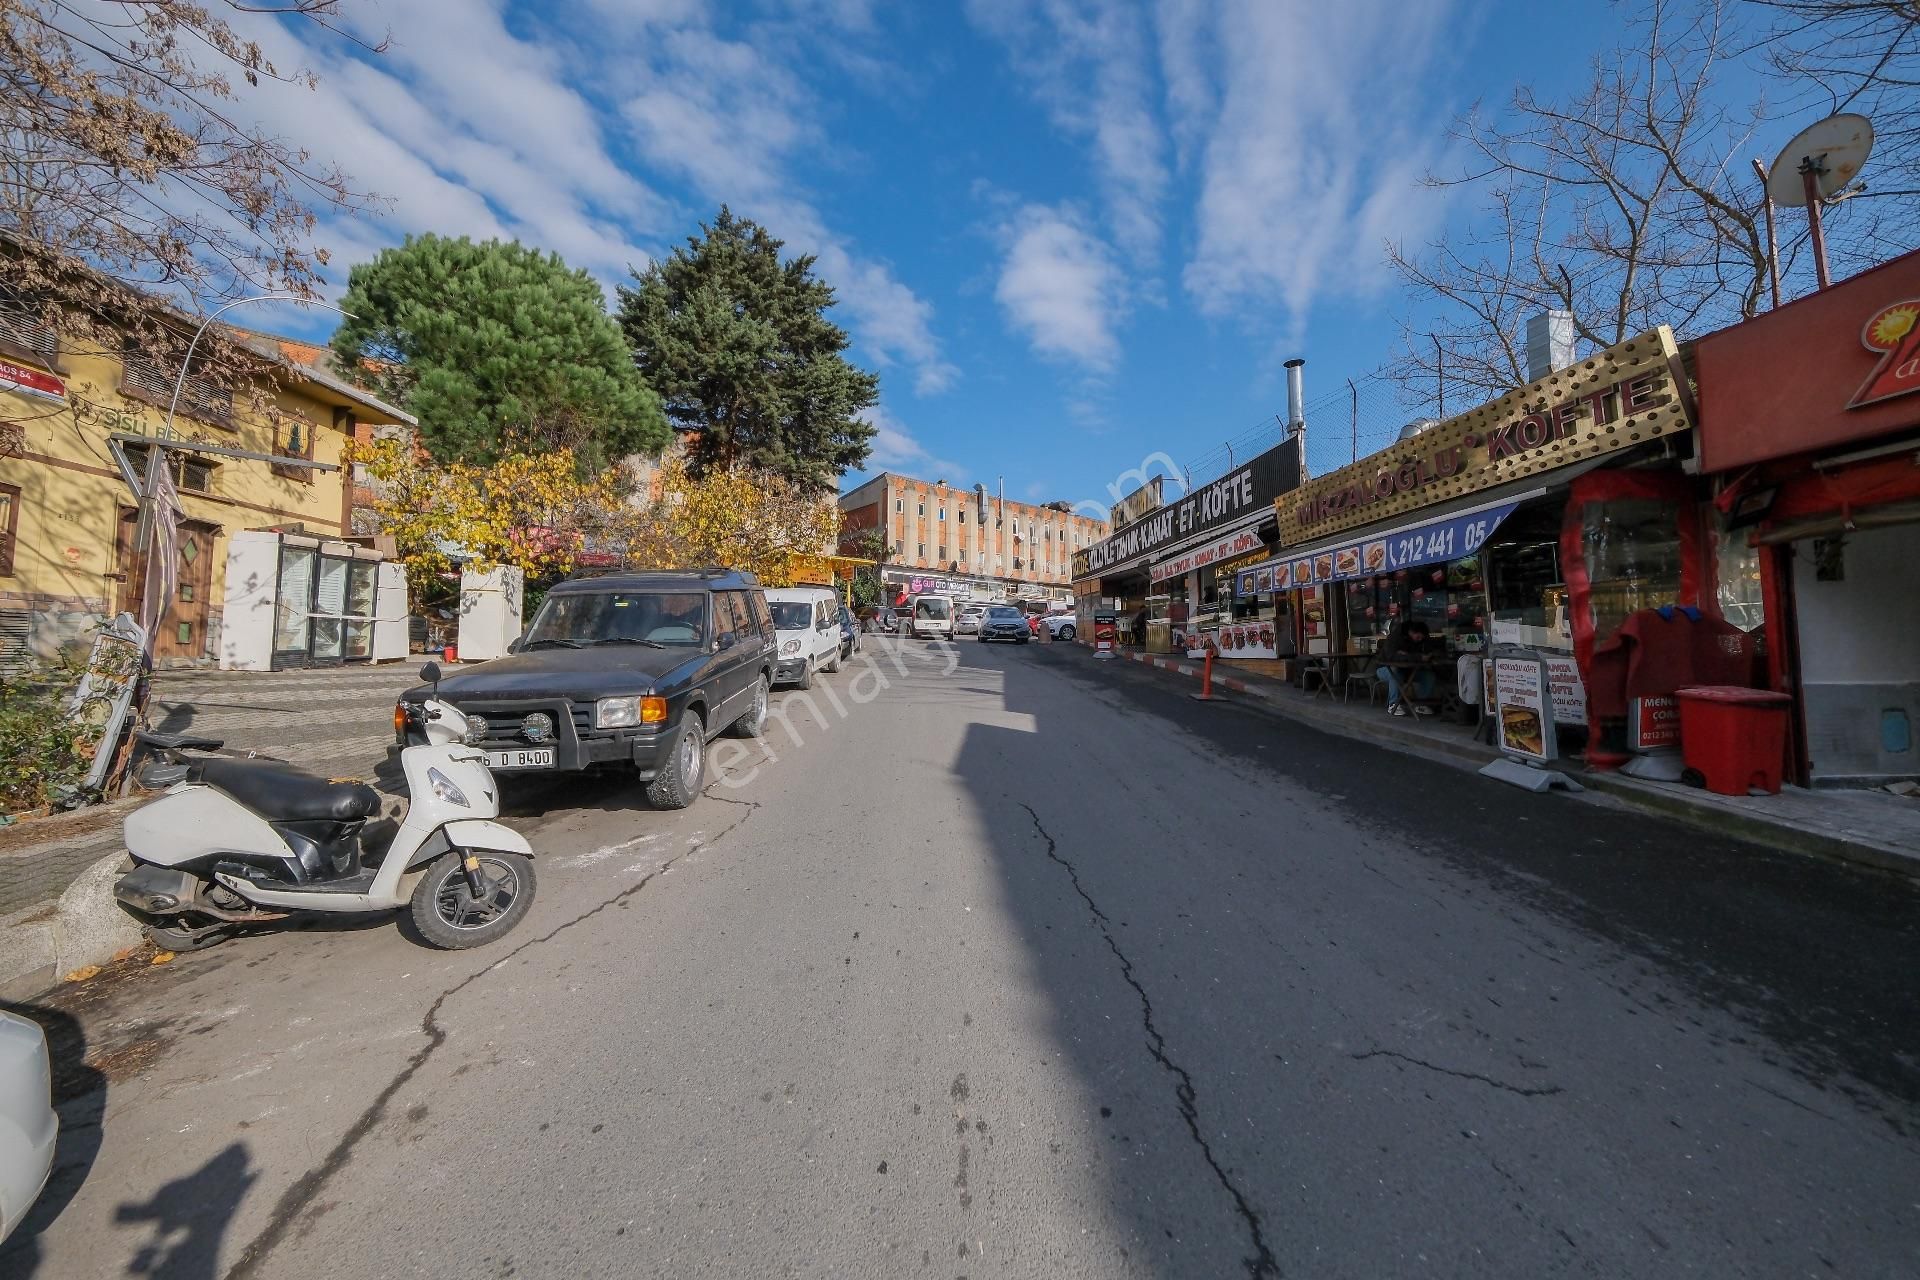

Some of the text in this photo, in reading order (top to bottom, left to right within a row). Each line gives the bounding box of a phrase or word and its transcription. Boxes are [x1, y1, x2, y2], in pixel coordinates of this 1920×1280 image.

[1487, 371, 1662, 462] KÖFTE
[1180, 501, 1195, 532] ET
[1202, 469, 1252, 523] KÖFTE
[1426, 528, 1454, 557] 441
[502, 753, 509, 766] D
[519, 751, 550, 765] 8400
